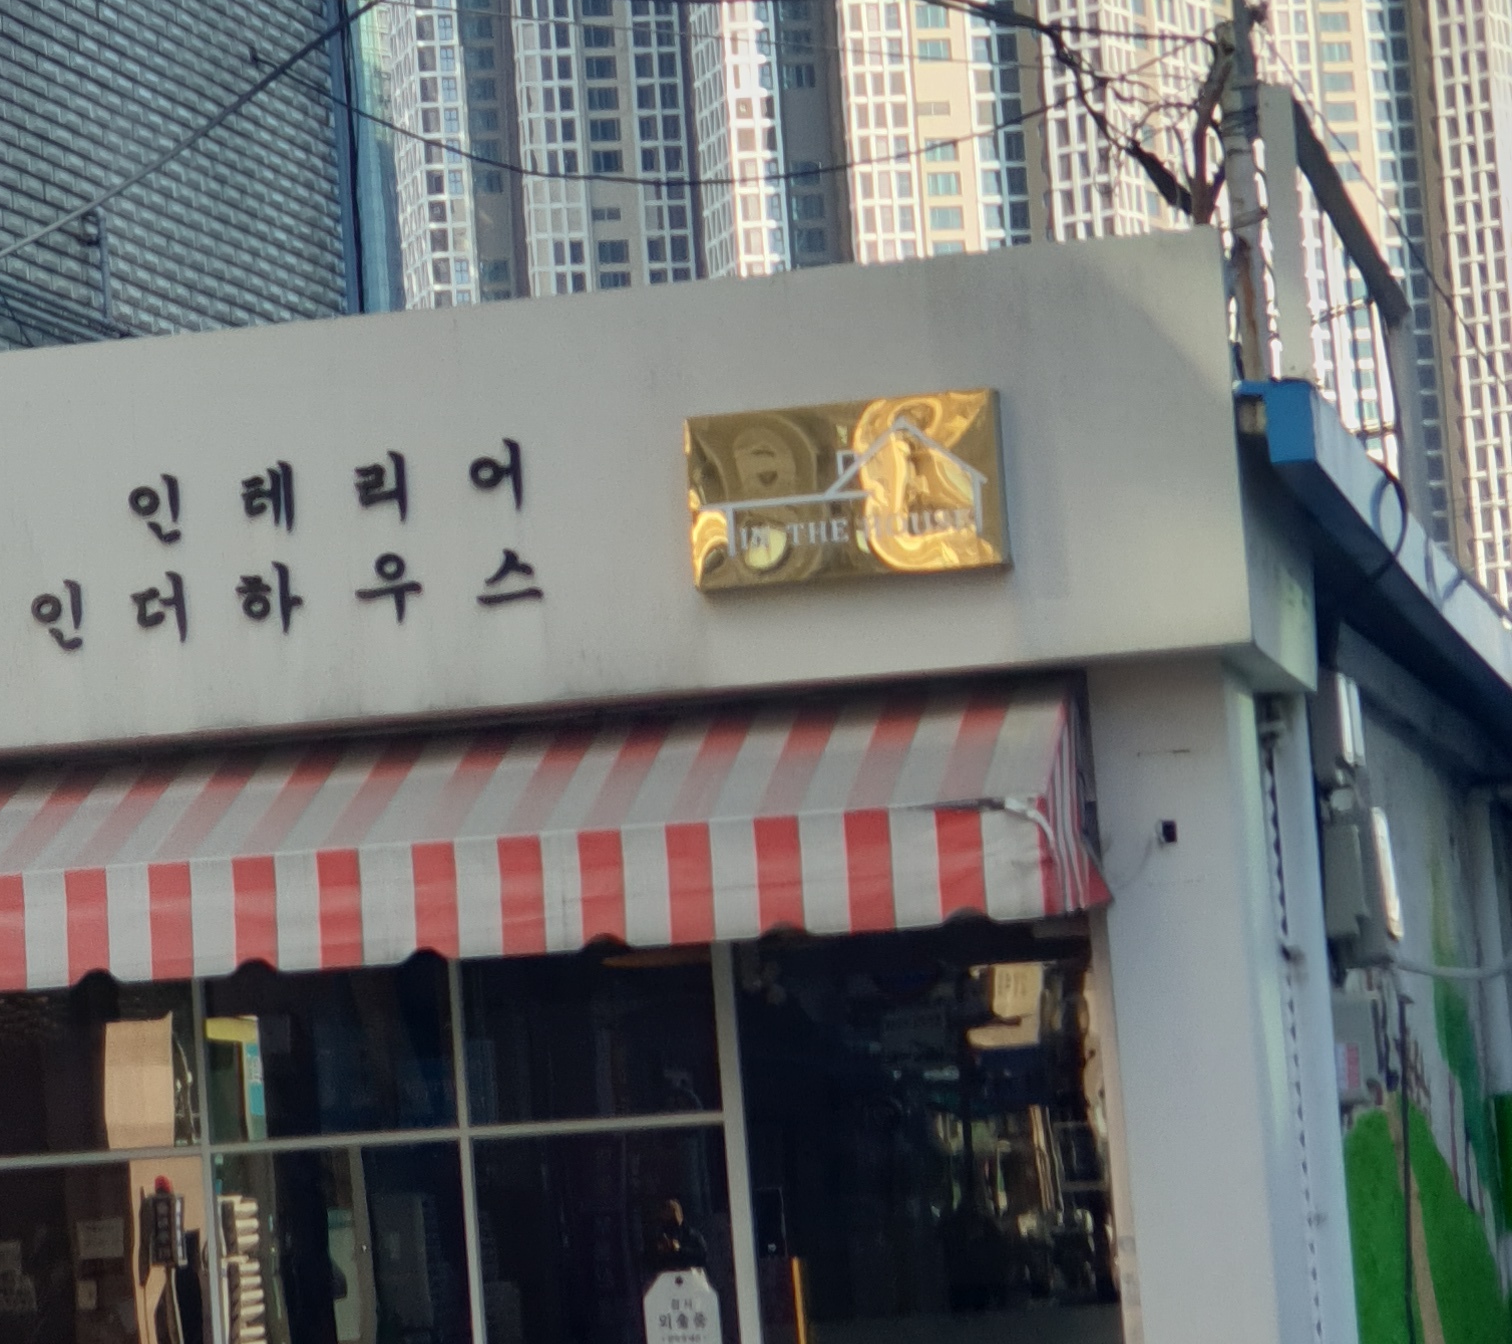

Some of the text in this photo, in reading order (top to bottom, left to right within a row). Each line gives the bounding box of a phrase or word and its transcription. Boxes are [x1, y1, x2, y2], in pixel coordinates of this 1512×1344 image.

[128, 437, 523, 542] 인테리어
[787, 517, 850, 545] THE
[30, 549, 543, 651] 인더하우스
